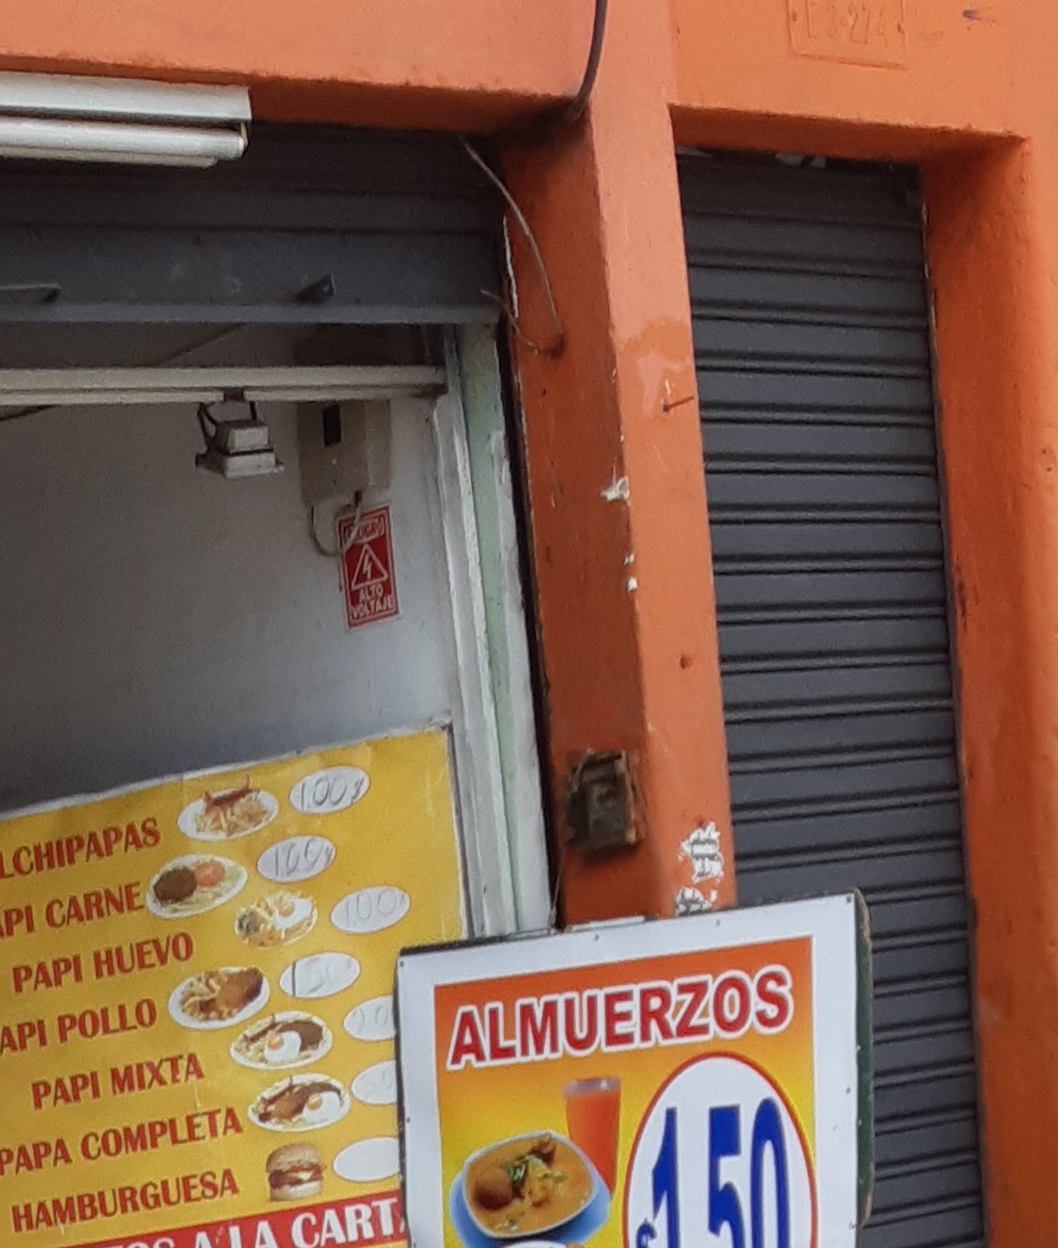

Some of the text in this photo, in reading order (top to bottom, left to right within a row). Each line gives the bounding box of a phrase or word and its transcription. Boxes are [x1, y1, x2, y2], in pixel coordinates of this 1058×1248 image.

[350, 595, 393, 619] VOLTAJE
[358, 584, 383, 602] ALTO
[45, 882, 145, 930] CARNE
[12, 932, 194, 994] PAPI HUEVO
[58, 1000, 157, 1044] POLLO
[446, 965, 794, 1070] ALMUERZOS
[30, 1053, 205, 1110] PAPI MIXTA
[80, 1107, 244, 1162] COMPLETA
[12, 1169, 239, 1233] HAMBURGUESA
